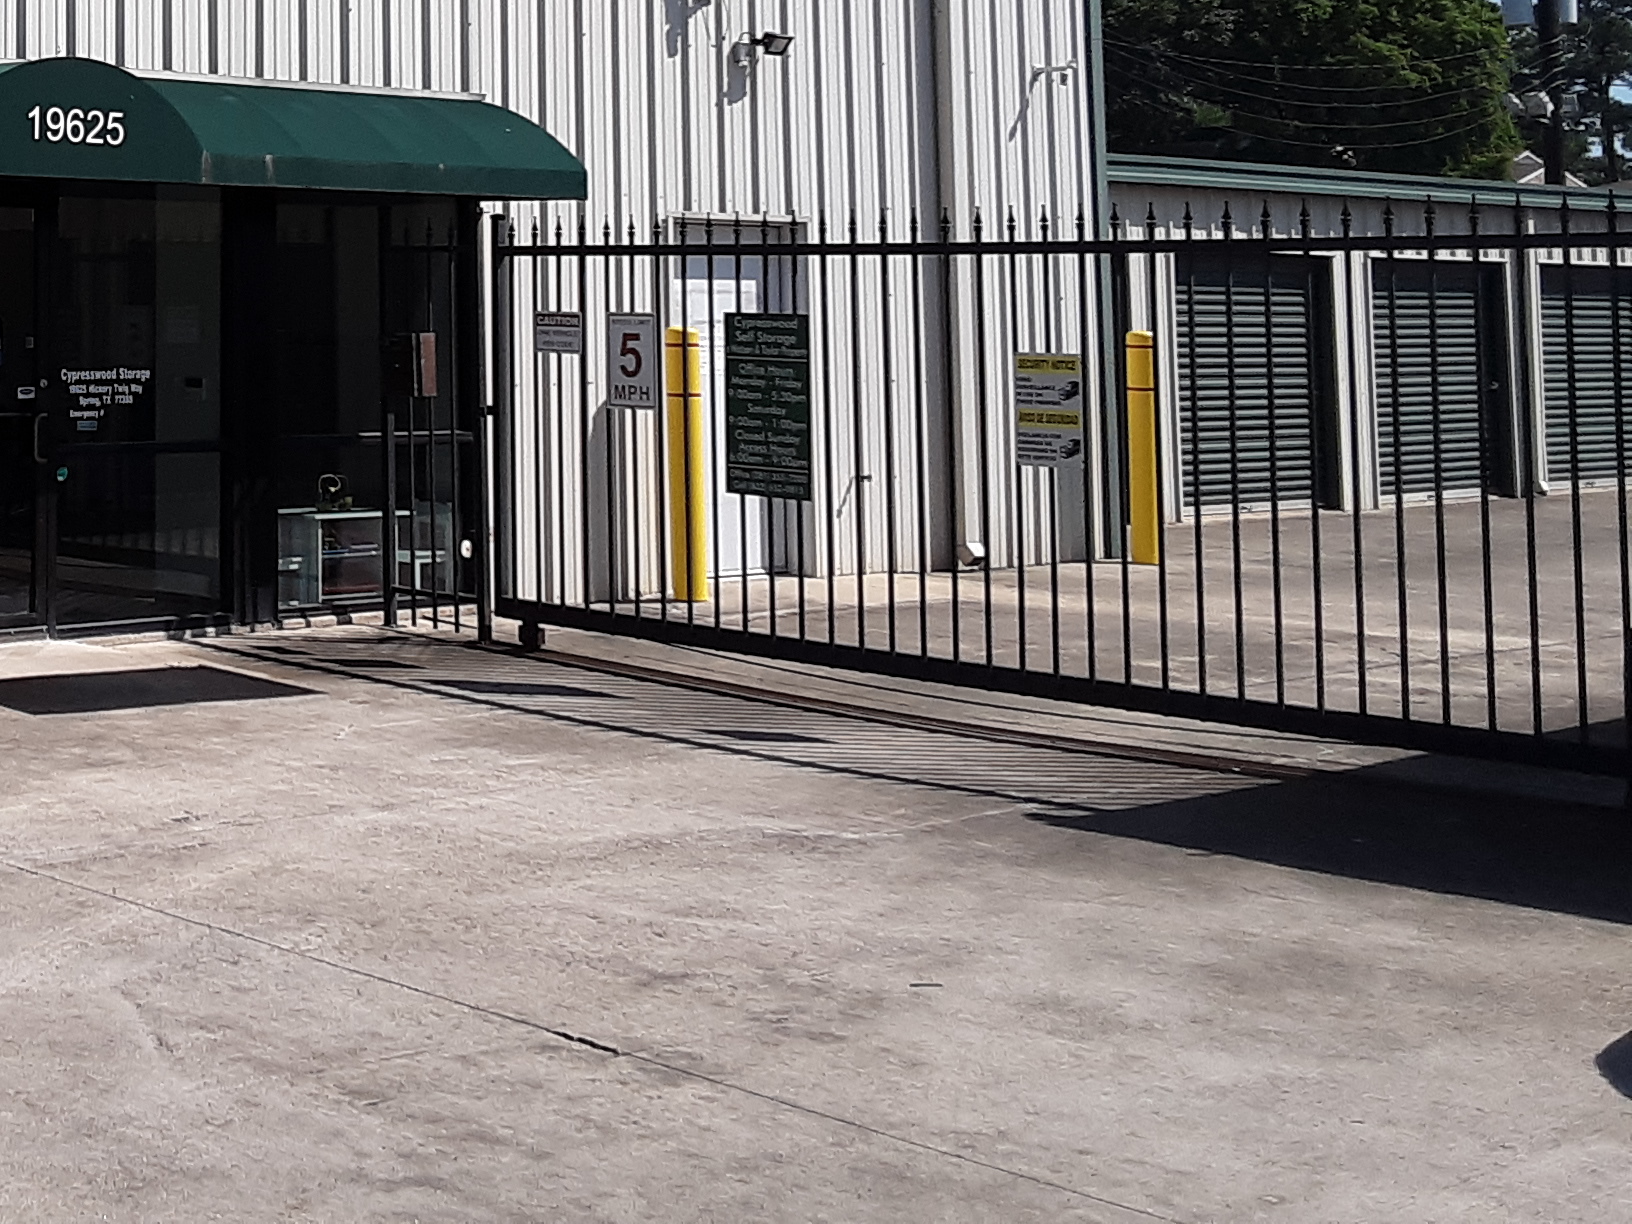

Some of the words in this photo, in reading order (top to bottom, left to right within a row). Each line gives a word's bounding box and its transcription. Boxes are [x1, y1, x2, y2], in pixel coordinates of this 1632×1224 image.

[28, 105, 125, 146] 19625
[536, 316, 579, 325] CAUTION
[733, 316, 798, 329] Cypresswood
[734, 330, 755, 342] Self
[756, 331, 798, 346] Storage
[620, 332, 643, 378] 5
[60, 367, 117, 383] Cypresswood
[119, 367, 150, 382] Storage
[613, 384, 651, 401] MPH
